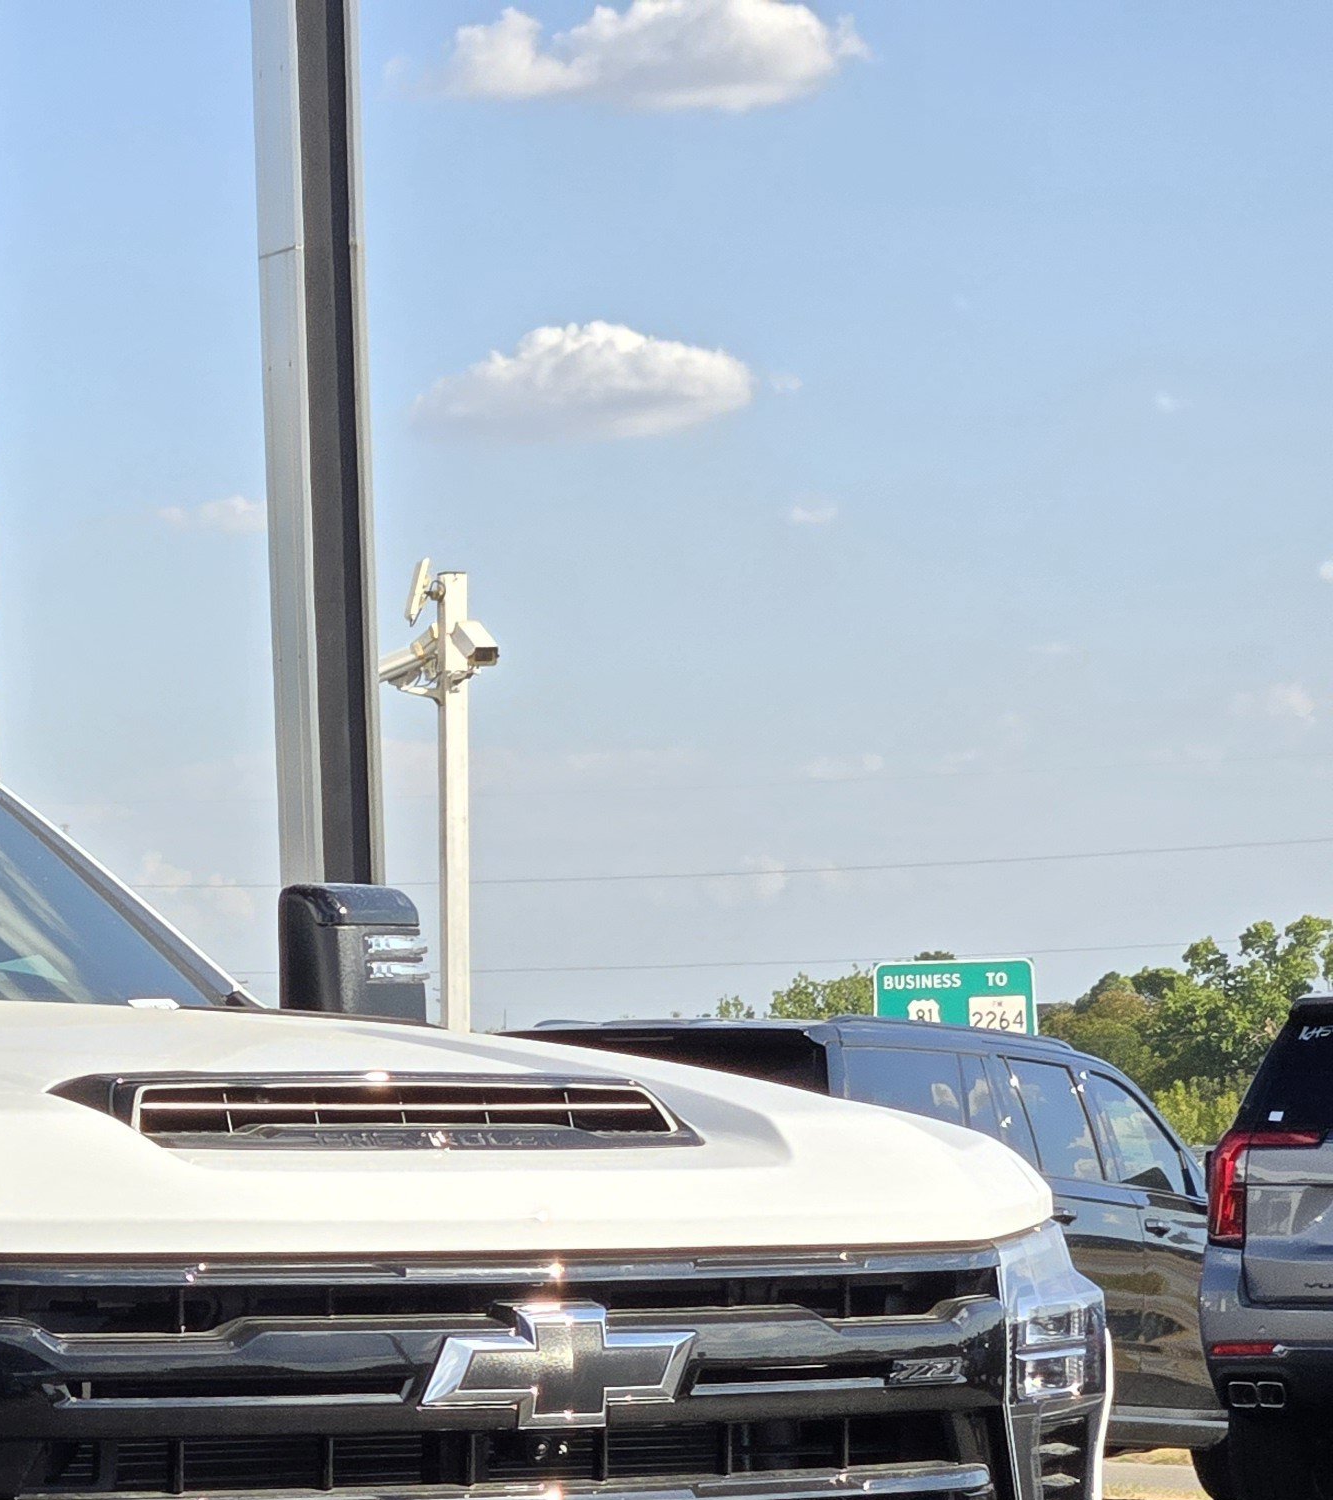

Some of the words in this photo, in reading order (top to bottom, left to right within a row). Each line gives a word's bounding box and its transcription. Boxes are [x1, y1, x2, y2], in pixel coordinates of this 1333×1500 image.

[883, 973, 962, 990] BUSINESS
[985, 971, 1008, 987] TO
[972, 1009, 1025, 1031] 2264
